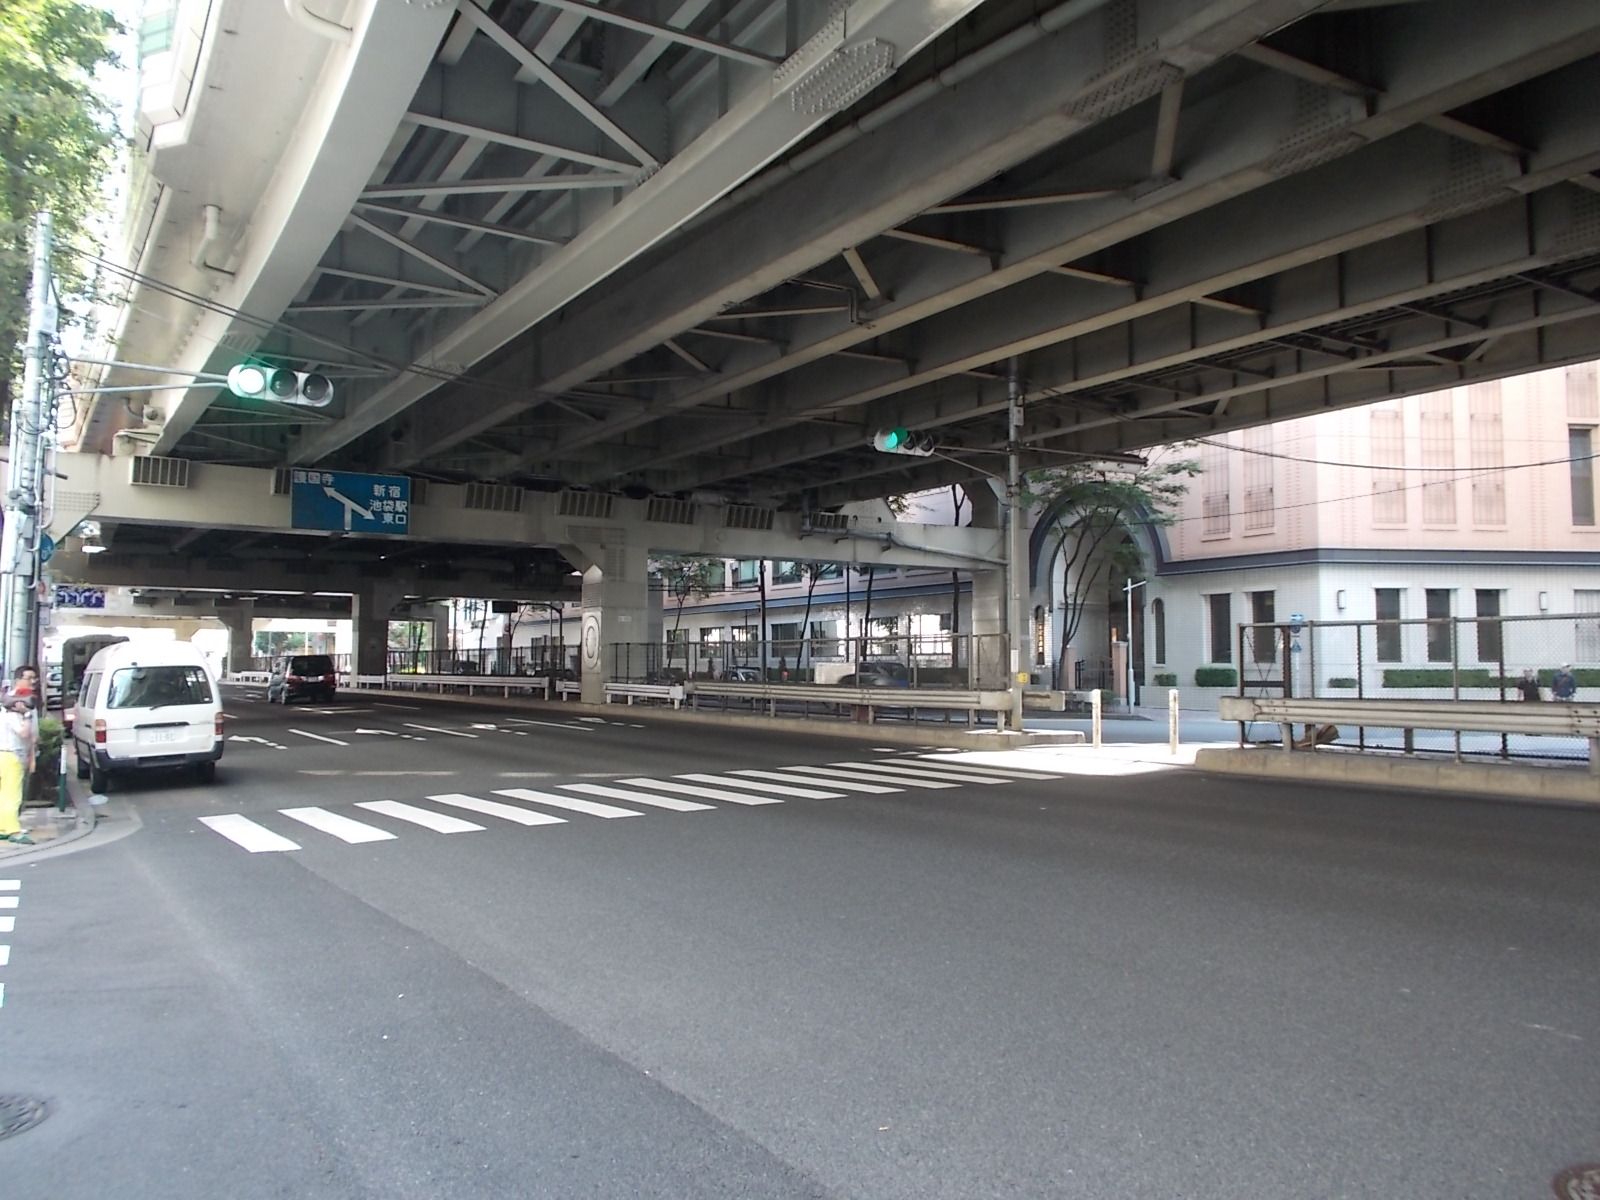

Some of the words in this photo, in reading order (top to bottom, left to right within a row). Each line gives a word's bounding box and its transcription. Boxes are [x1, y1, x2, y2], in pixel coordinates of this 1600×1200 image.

[373, 484, 401, 498] 新宿
[369, 499, 407, 513] 池袋駅
[381, 513, 407, 525] 東口
